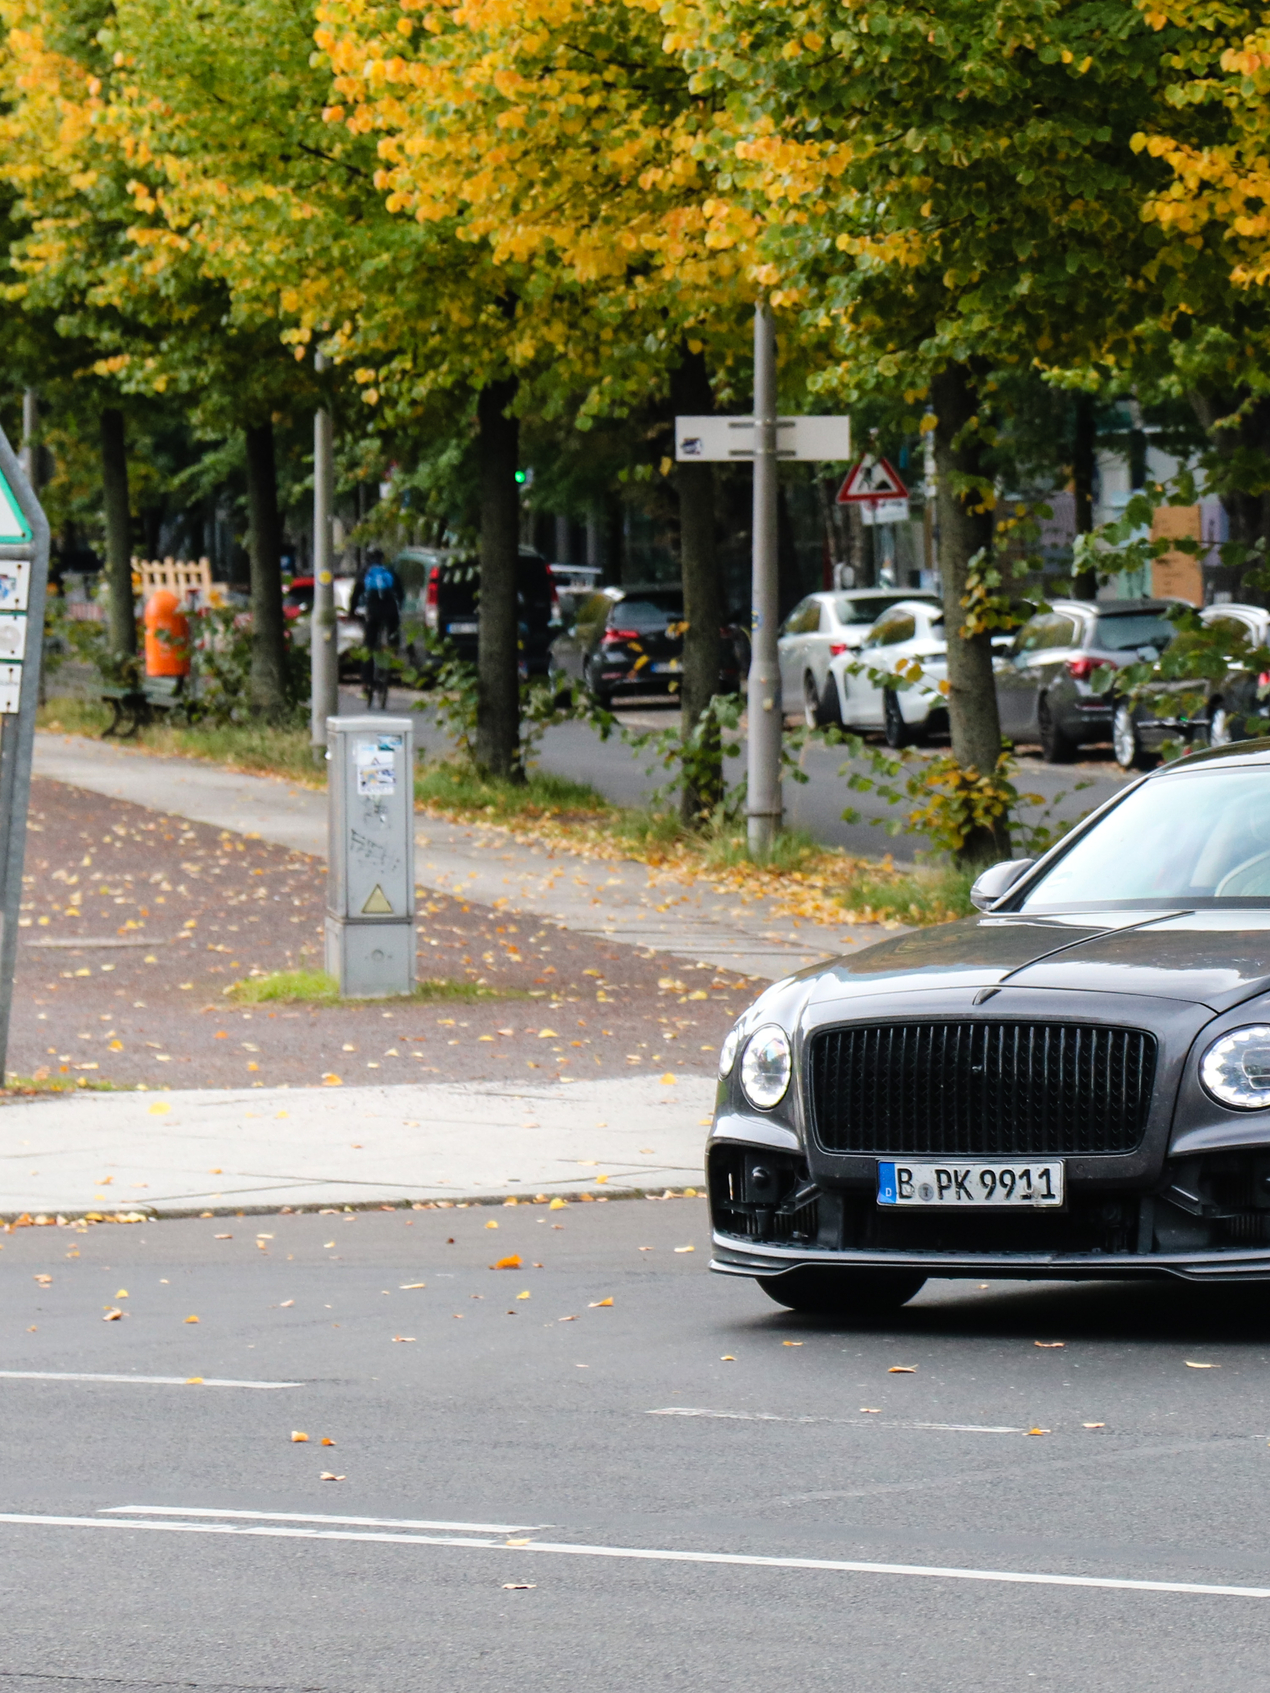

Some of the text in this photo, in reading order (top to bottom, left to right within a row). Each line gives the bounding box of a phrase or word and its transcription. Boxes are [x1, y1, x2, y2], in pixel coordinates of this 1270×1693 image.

[885, 1187, 892, 1197] D
[897, 1167, 1056, 1200] B PK 9911
